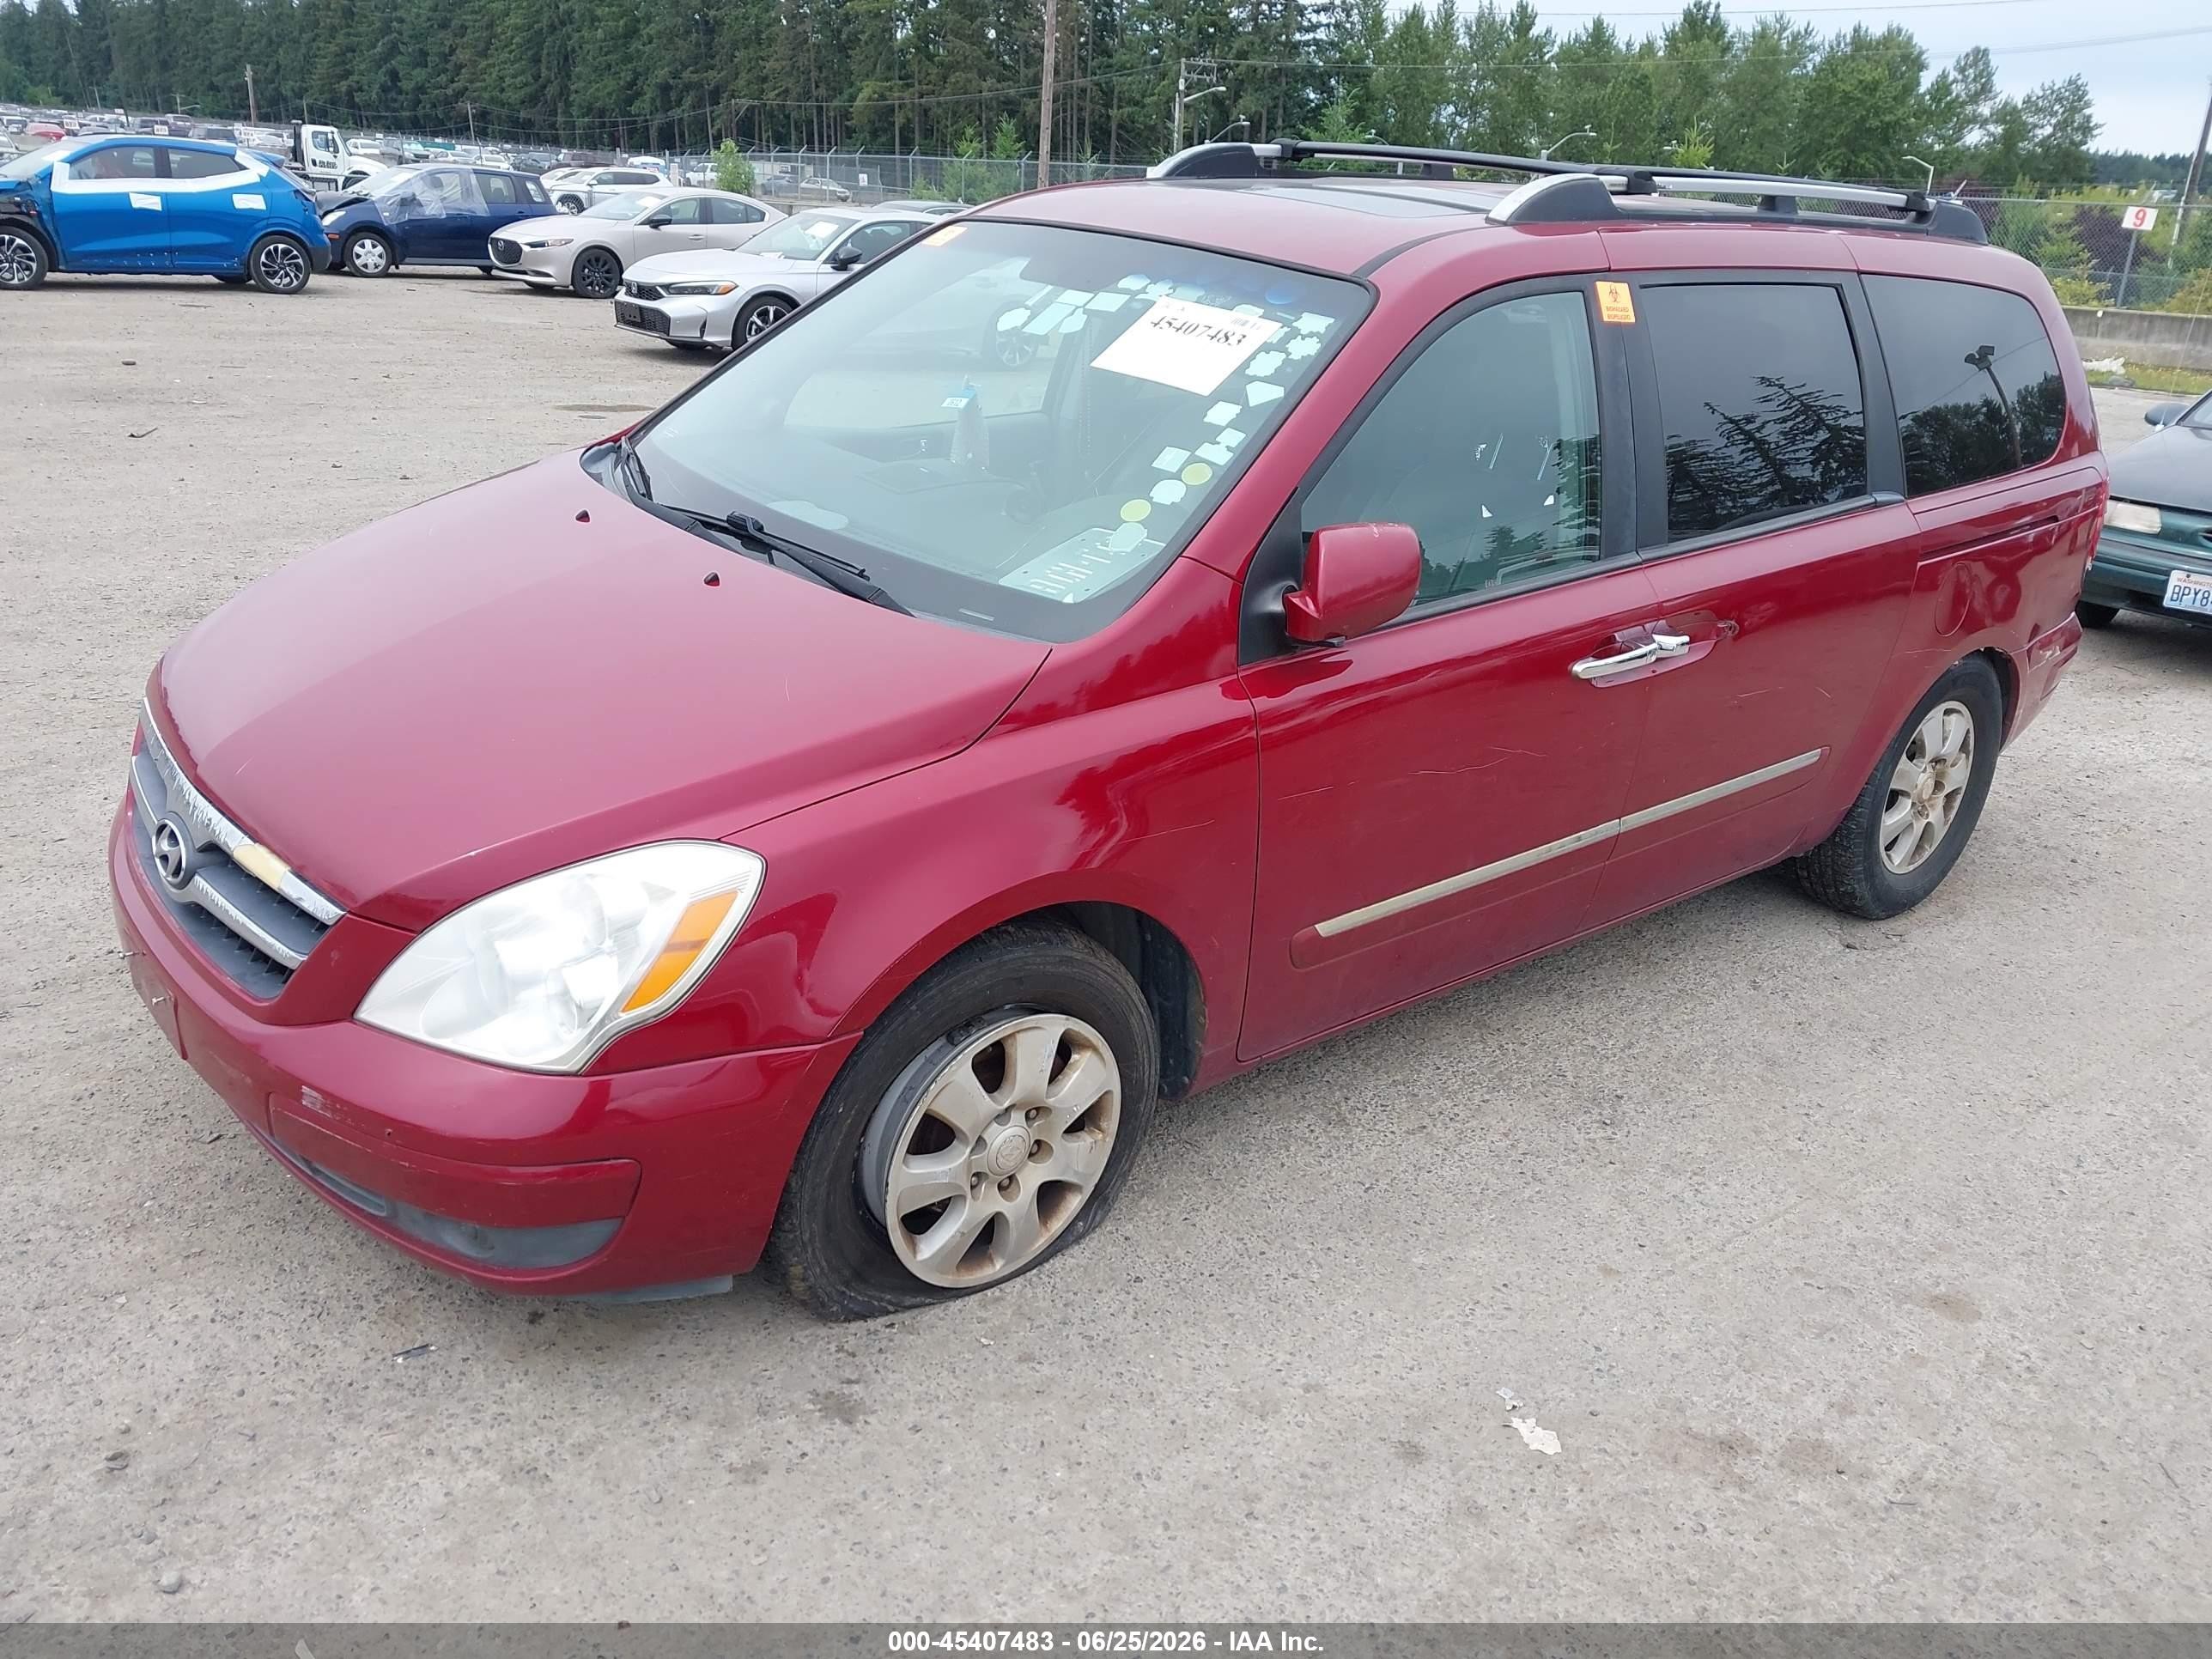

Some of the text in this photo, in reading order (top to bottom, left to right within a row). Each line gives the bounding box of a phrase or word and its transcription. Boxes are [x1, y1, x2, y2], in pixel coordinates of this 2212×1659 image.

[2133, 208, 2147, 228] 9
[1150, 315, 1248, 346] 45407483
[2170, 585, 2212, 607] BPY8
